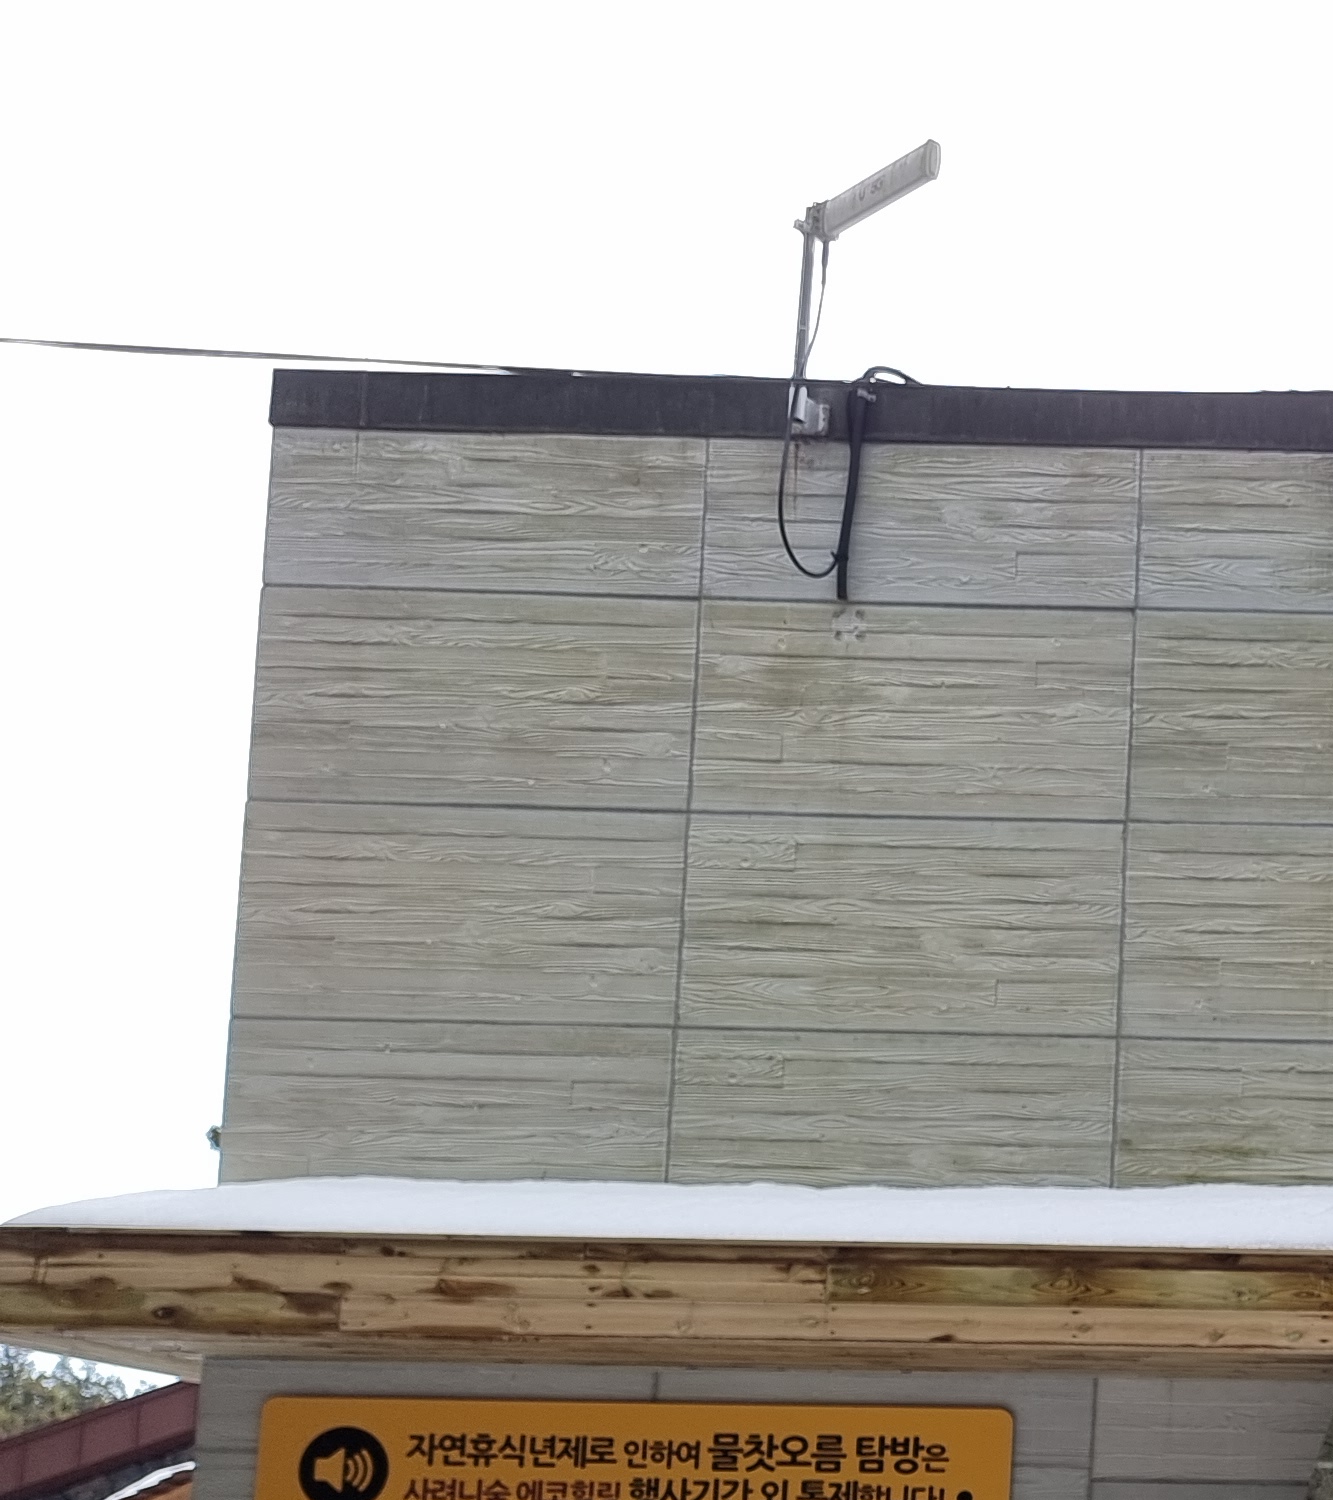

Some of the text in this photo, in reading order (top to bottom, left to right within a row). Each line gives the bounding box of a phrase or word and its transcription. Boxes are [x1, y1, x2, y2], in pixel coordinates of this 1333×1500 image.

[405, 1431, 950, 1475] 자연휴식년제로 인하여 물찻오름 탐방은
